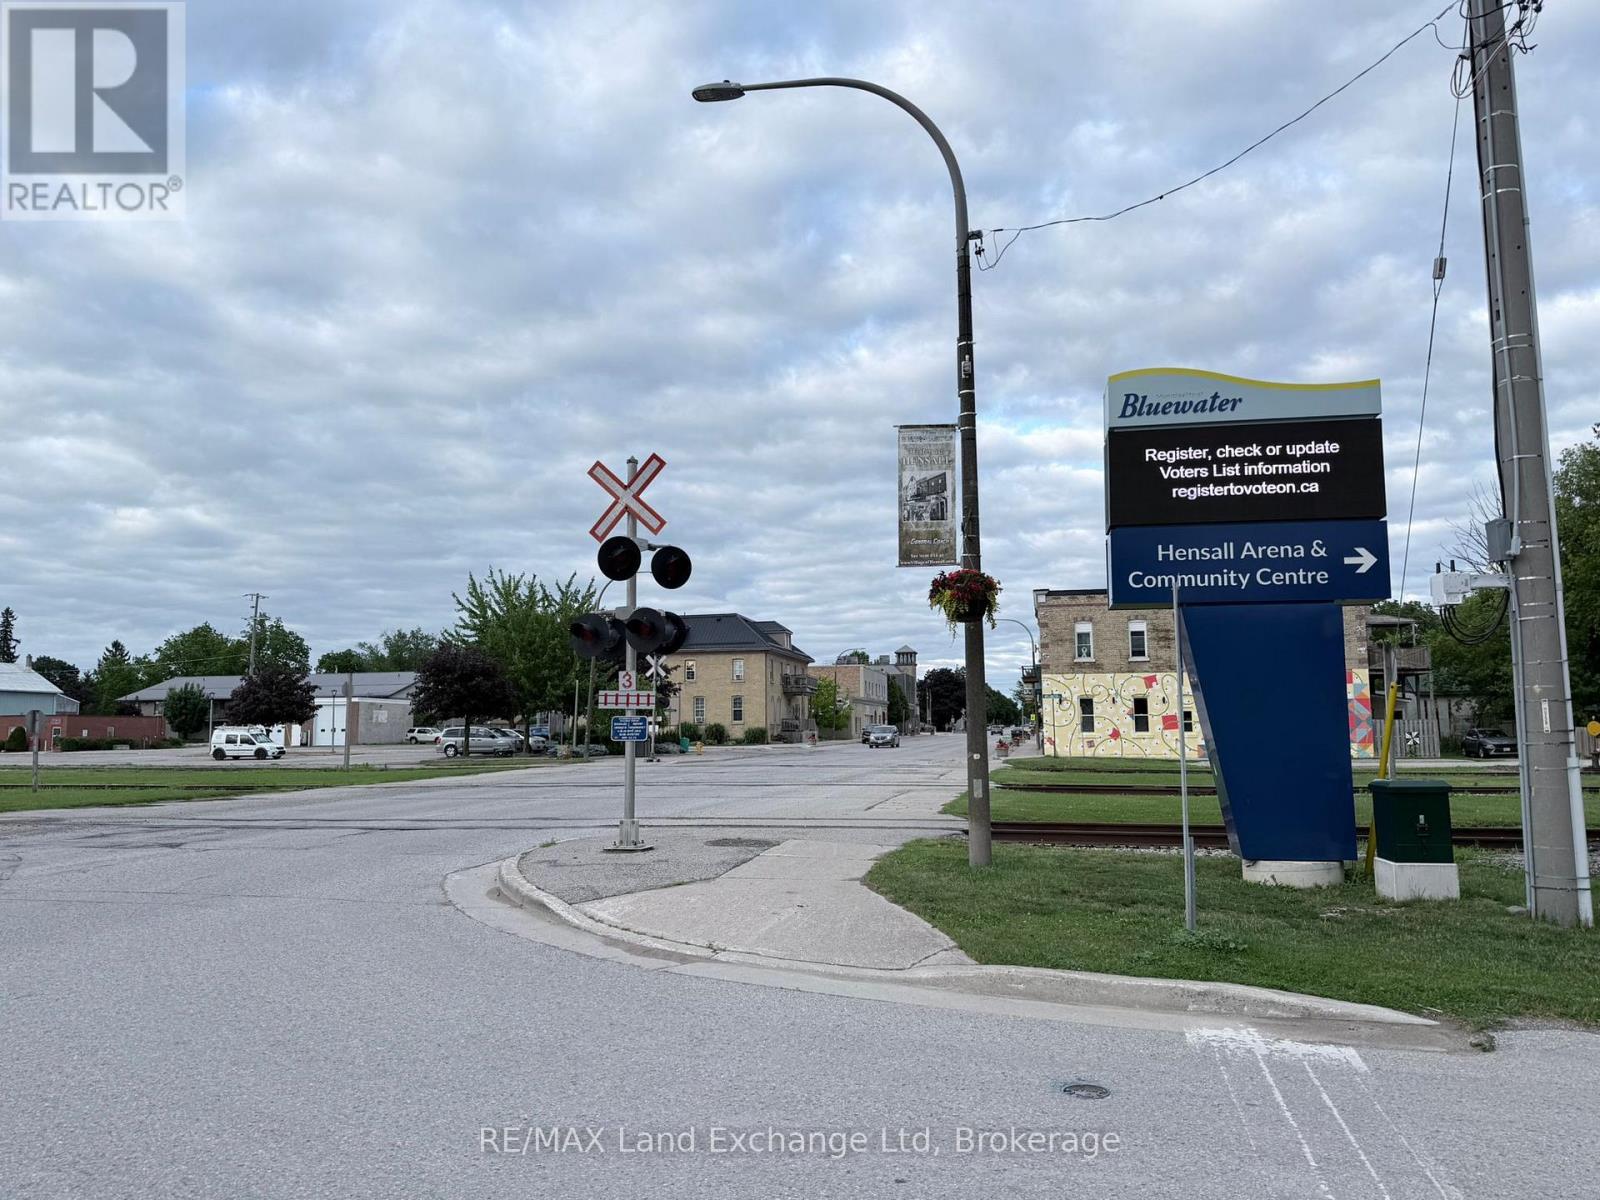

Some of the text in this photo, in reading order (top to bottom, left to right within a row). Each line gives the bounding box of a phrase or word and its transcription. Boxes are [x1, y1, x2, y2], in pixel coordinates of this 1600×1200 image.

[1118, 391, 1243, 419] Bluewater
[1145, 440, 1340, 462] Register, check or update
[1160, 459, 1331, 480] Voters List information
[1172, 481, 1320, 500] registertovoteon.ca
[1157, 539, 1328, 561] Hensall Arena &
[1128, 567, 1329, 590] Community Centre
[622, 671, 633, 689] 3
